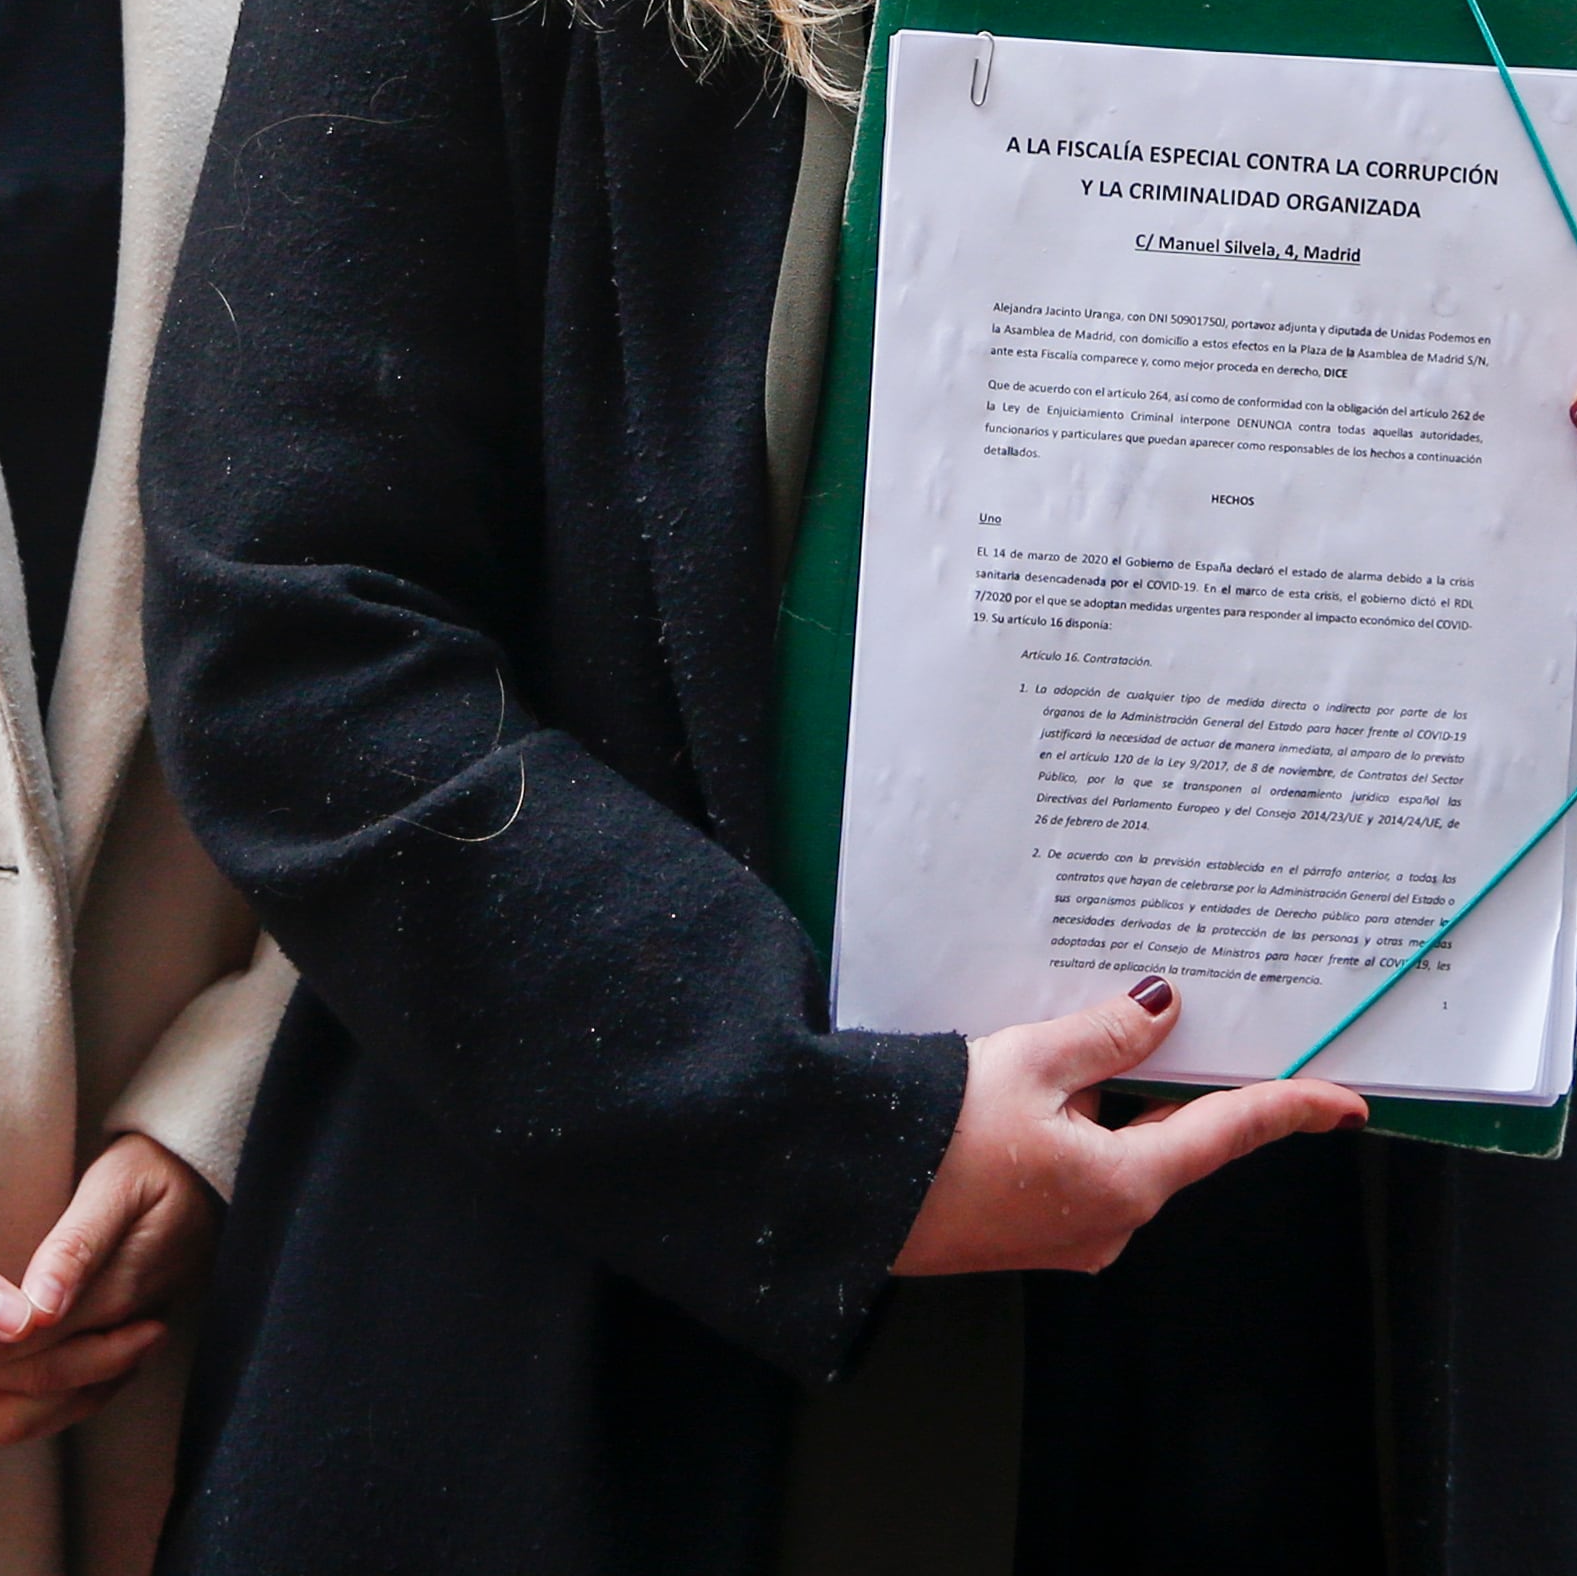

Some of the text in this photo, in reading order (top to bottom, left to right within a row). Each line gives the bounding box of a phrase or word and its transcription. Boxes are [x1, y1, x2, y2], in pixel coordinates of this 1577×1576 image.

[1005, 136, 1499, 186] A LA FISCALÍA ESPECIAL CONTRA LA CORRUPCIÓN
[1080, 178, 1422, 219] Y LA CRIMINALIDAD ORGANIZADA
[1135, 233, 1361, 263] C/ Manuel Silvela, 4, Madrid
[992, 302, 1043, 316] Alejandra
[1045, 306, 1082, 318] Jacinto
[1127, 313, 1146, 322] con
[1148, 312, 1168, 323] DNI
[1231, 320, 1276, 331] portavoz
[1278, 321, 1318, 334] adjunta
[1319, 326, 1326, 336] y
[1327, 324, 1373, 337] diputada
[1374, 327, 1388, 338] de
[1390, 328, 1426, 341] Unidas
[1428, 331, 1476, 344] Podemos
[1477, 336, 1492, 345] en
[991, 323, 1001, 334] la
[1003, 324, 1055, 338] Asamblea
[1057, 328, 1072, 339] de
[1119, 334, 1139, 343] con
[1191, 339, 1199, 348] a
[1201, 339, 1229, 350] estos
[1231, 340, 1270, 353] efectos
[1272, 345, 1286, 353] en
[1288, 343, 1298, 354] la
[1300, 344, 1327, 356] Plaza
[1329, 346, 1344, 357] de
[1346, 347, 1356, 359] la
[1357, 348, 1408, 361] Asamblea
[1410, 351, 1425, 362] de
[1426, 352, 1465, 365] Madrid
[990, 347, 1014, 357] ante
[1016, 348, 1038, 359] esta
[1080, 353, 1139, 366] comparece
[1151, 358, 1181, 368] como
[1183, 359, 1215, 372] mejor
[1216, 362, 1259, 373] proceda
[1261, 365, 1275, 374] en
[1323, 367, 1349, 379] DICE
[986, 400, 996, 412] la
[1002, 402, 1021, 415] Ley
[1026, 403, 1040, 415] de
[1046, 405, 1125, 420] Enjuiciamiento
[1130, 410, 1174, 423] Criminal
[1180, 414, 1231, 427] interpone
[1236, 417, 1293, 431] DENUNCIA
[1298, 423, 1331, 434] contra
[1337, 424, 1366, 436] todas
[1372, 427, 1414, 439] aquellas
[983, 445, 1042, 458] detallados.
[985, 422, 1483, 465] funcionarios y particulares que puedan aparecer como responsables de los hechos a continuación
[1211, 493, 1255, 507] HECHOS
[979, 512, 1002, 526] Uno
[975, 570, 1021, 582] sanitaria
[1024, 571, 1107, 588] desencadenada
[1110, 579, 1129, 590] por
[1132, 578, 1143, 590] el
[1203, 583, 1217, 593] En
[1220, 584, 1232, 595] el
[1235, 587, 1268, 597] marco
[1270, 587, 1285, 598] de
[1288, 590, 1311, 600] esta
[1347, 591, 1357, 602] el
[1360, 593, 1407, 606] gobierno
[1440, 598, 1450, 608] el
[991, 613, 1005, 624] Su
[1007, 615, 1048, 627] artículo
[1050, 617, 1064, 628] 16
[1020, 649, 1062, 662] Artículo
[1082, 652, 1154, 667] Contratación.
[1042, 706, 1467, 742] órganos de la Administración General del Estado para hacer frente al COVID-19
[1034, 814, 1151, 830] 26 de febrero de 2014.
[1036, 792, 1088, 805] Directivas
[1091, 795, 1109, 806] del
[1112, 797, 1173, 811] Parlamento
[1176, 801, 1221, 815] Europeo
[1224, 807, 1232, 817] y
[1234, 806, 1253, 817] del
[1255, 807, 1297, 821] Consejo
[1300, 809, 1364, 824] 2014/23/UE
[1366, 816, 1374, 826] y
[1446, 818, 1461, 829] de
[1097, 959, 1112, 971] de
[1112, 961, 1166, 972] aplicación
[1168, 964, 1179, 975] la
[1180, 966, 1242, 980] tramitación
[1243, 971, 1258, 981] de
[1259, 974, 1324, 986] emergencia.
